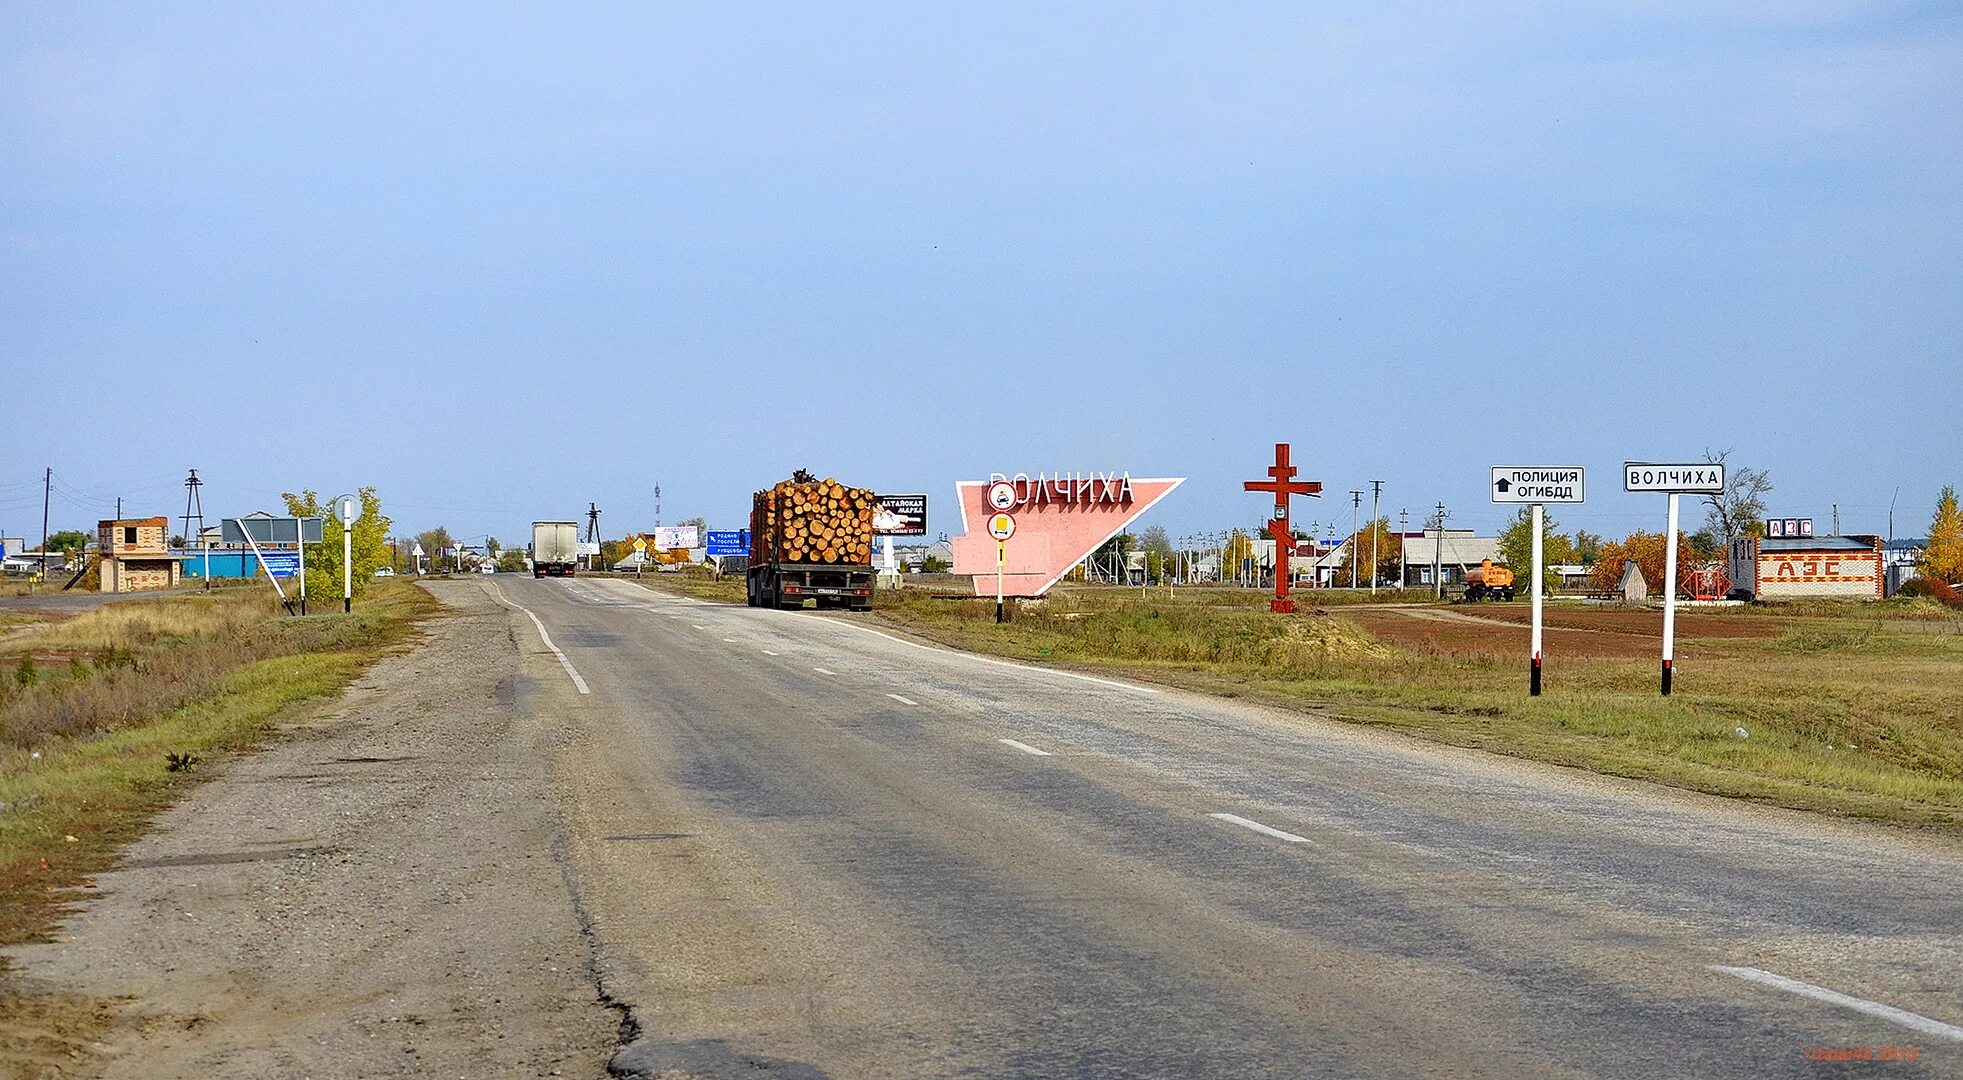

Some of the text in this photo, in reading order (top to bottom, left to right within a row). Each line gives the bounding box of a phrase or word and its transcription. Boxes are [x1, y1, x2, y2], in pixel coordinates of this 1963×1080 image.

[1512, 471, 1578, 485] ПОЛИЦИЯ
[1630, 470, 1718, 485] ВОЛЧИХА
[1517, 486, 1573, 499] ОГИБДД
[1772, 522, 1811, 534] АЗС
[1777, 561, 1840, 576] АЗС
